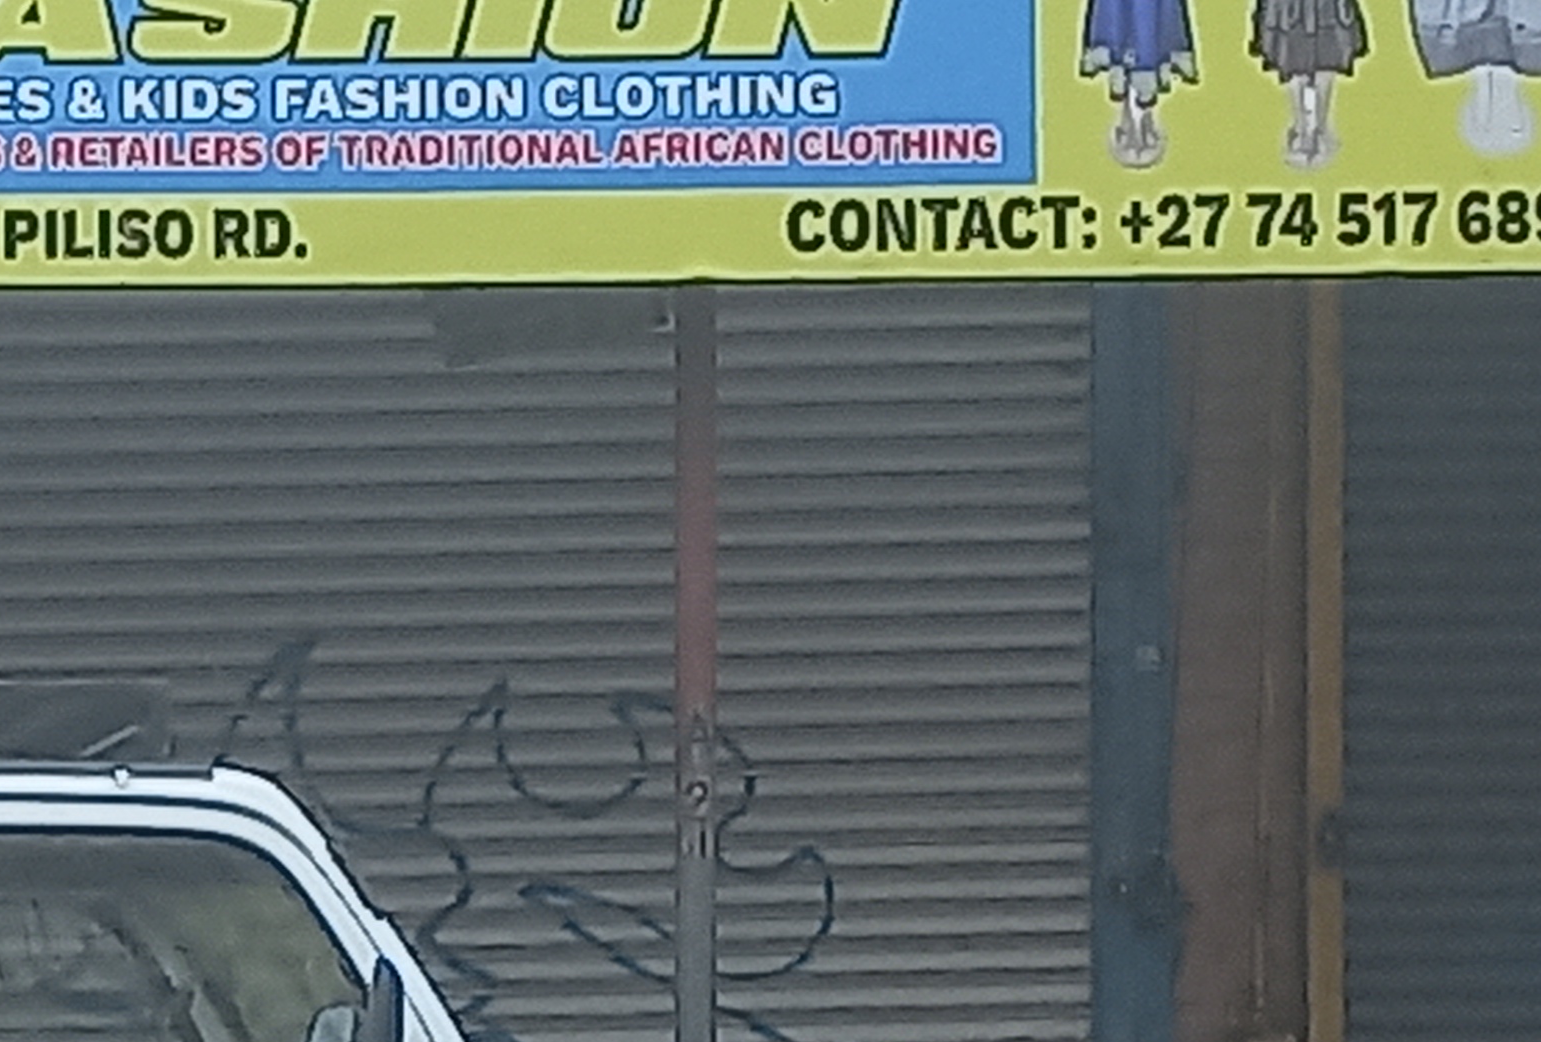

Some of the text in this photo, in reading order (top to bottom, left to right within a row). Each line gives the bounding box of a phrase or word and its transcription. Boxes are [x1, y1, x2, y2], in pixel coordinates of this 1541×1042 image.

[67, 77, 106, 122] &
[122, 76, 259, 121] KIDS
[274, 75, 524, 121] FASHION
[542, 73, 838, 118] CLOTHING
[16, 136, 36, 168] &
[51, 134, 262, 168] RETAILERS
[276, 134, 326, 167] OF
[339, 131, 602, 167] TRADITIONAL
[617, 130, 784, 164] AFRICAN
[798, 128, 998, 163] CLOTHING
[4, 208, 193, 261] PILISO
[213, 208, 308, 260] RD.
[785, 189, 1541, 252] CONTACT: +27 74 517 68
